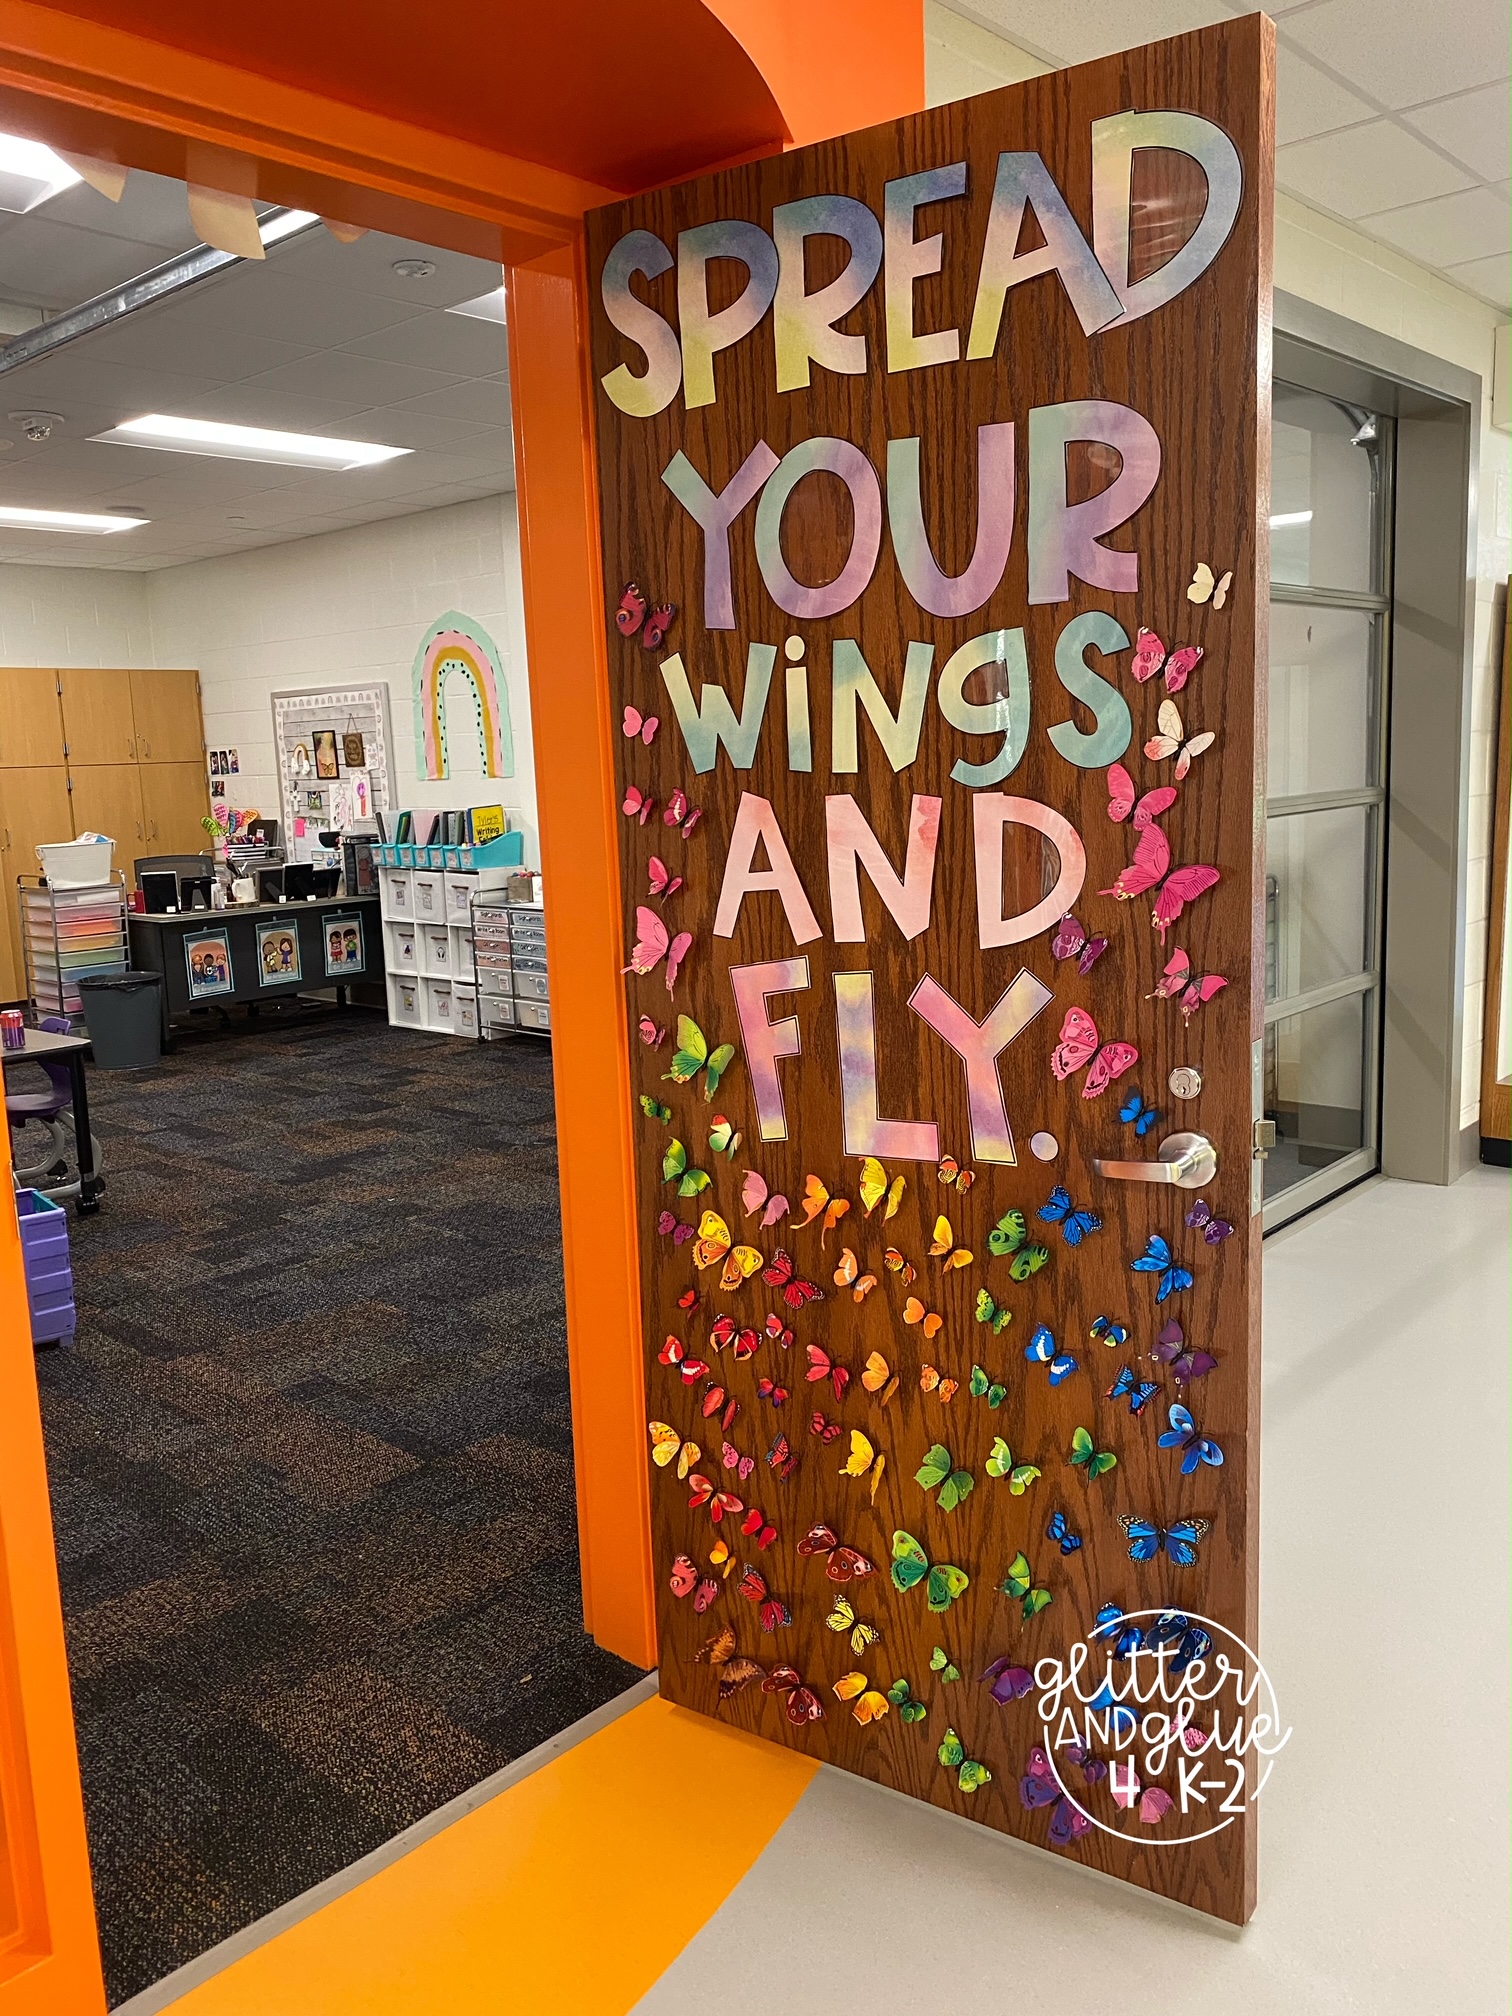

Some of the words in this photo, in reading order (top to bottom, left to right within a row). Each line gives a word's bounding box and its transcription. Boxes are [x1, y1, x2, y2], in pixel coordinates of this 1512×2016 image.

[601, 108, 1243, 418] SPREAD
[661, 398, 1161, 630] YOUR
[476, 827, 499, 836] Writing
[712, 790, 1087, 949] AND
[729, 955, 1059, 1166] FLY.
